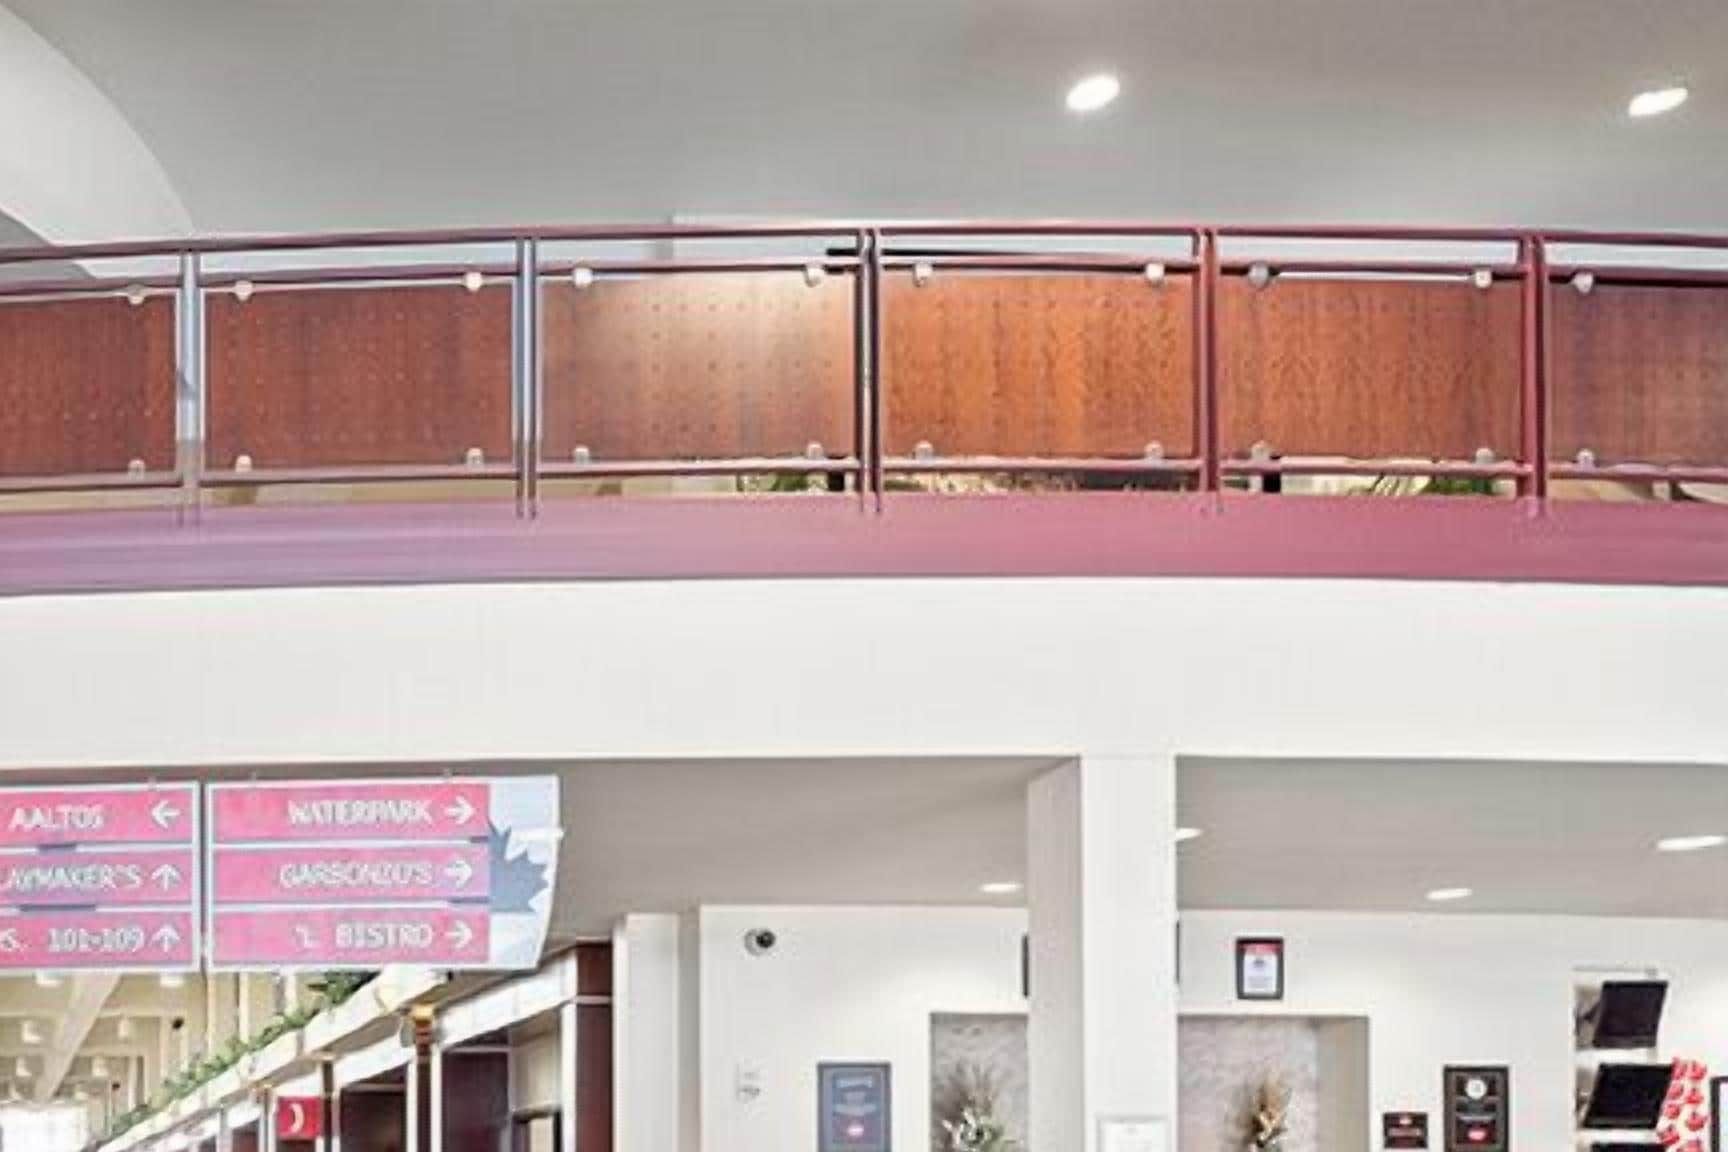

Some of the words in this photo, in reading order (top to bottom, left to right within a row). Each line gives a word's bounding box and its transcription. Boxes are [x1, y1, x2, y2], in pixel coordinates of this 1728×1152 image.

[8, 804, 105, 830] AALTOS
[287, 799, 434, 825] WATERPARK
[335, 921, 433, 948] BISTRO
